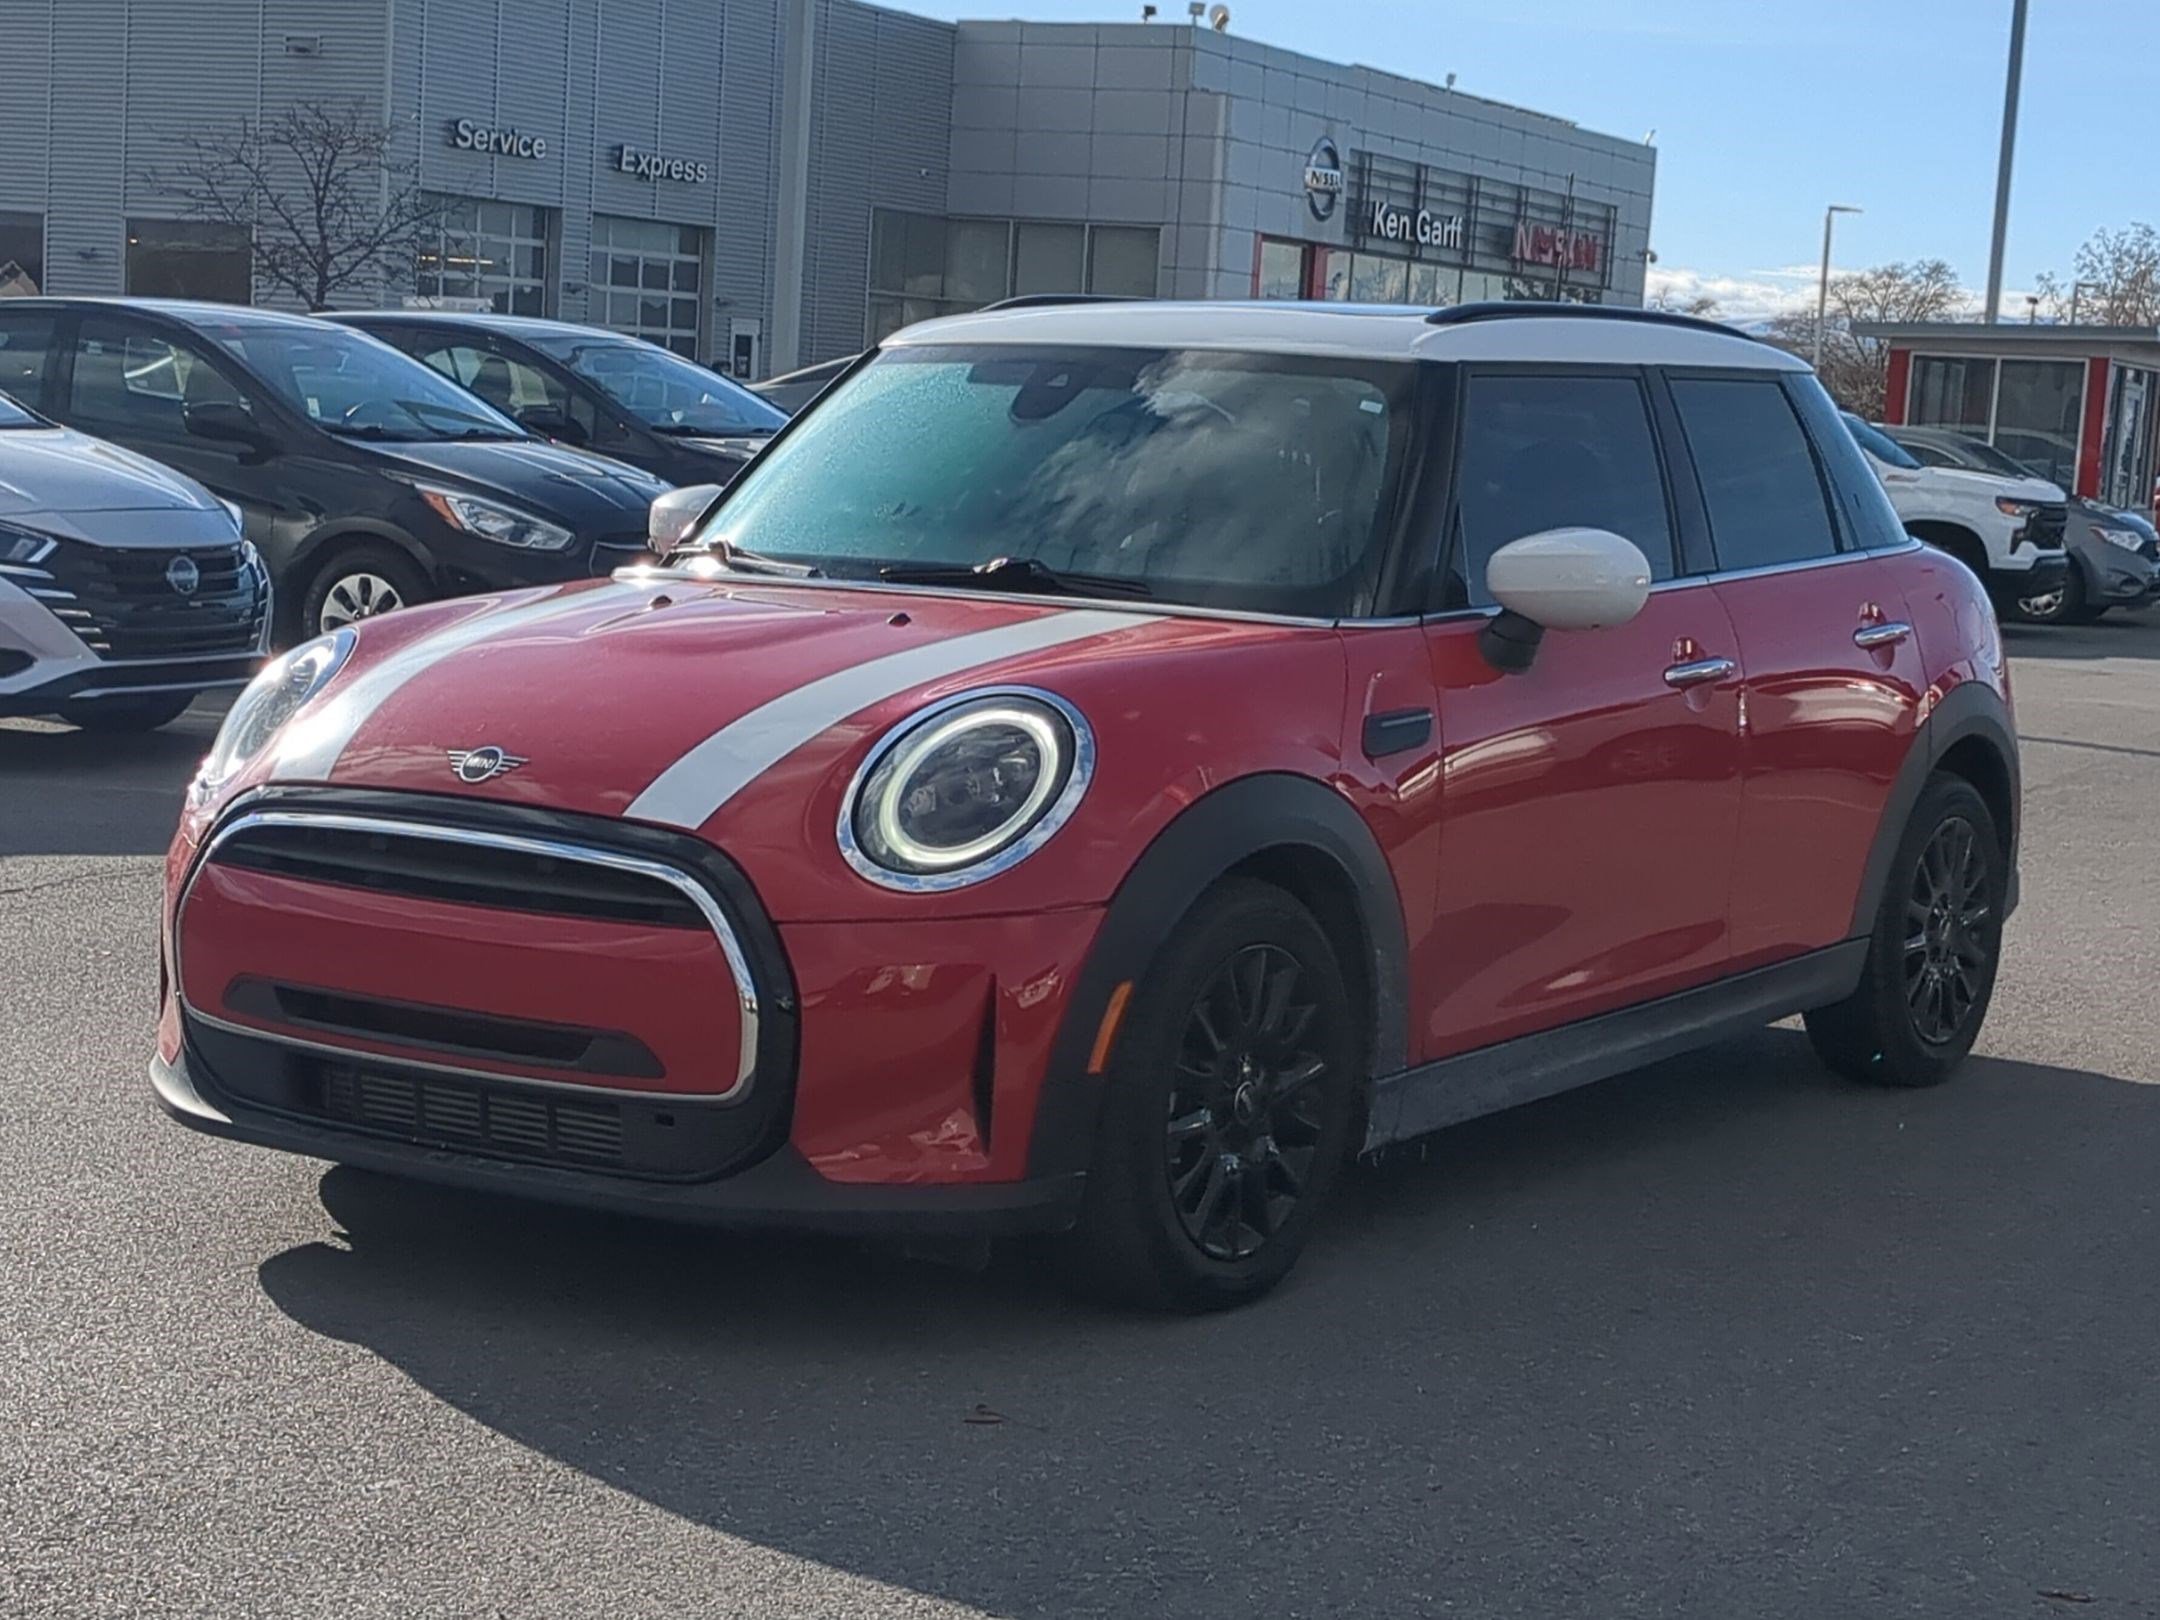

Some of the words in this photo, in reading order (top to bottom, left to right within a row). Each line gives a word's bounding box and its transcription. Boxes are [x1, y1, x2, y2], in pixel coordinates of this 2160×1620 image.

[455, 118, 547, 159] Service
[620, 144, 708, 183] Express
[1372, 201, 1411, 241] Ken
[1415, 209, 1463, 249] Garff
